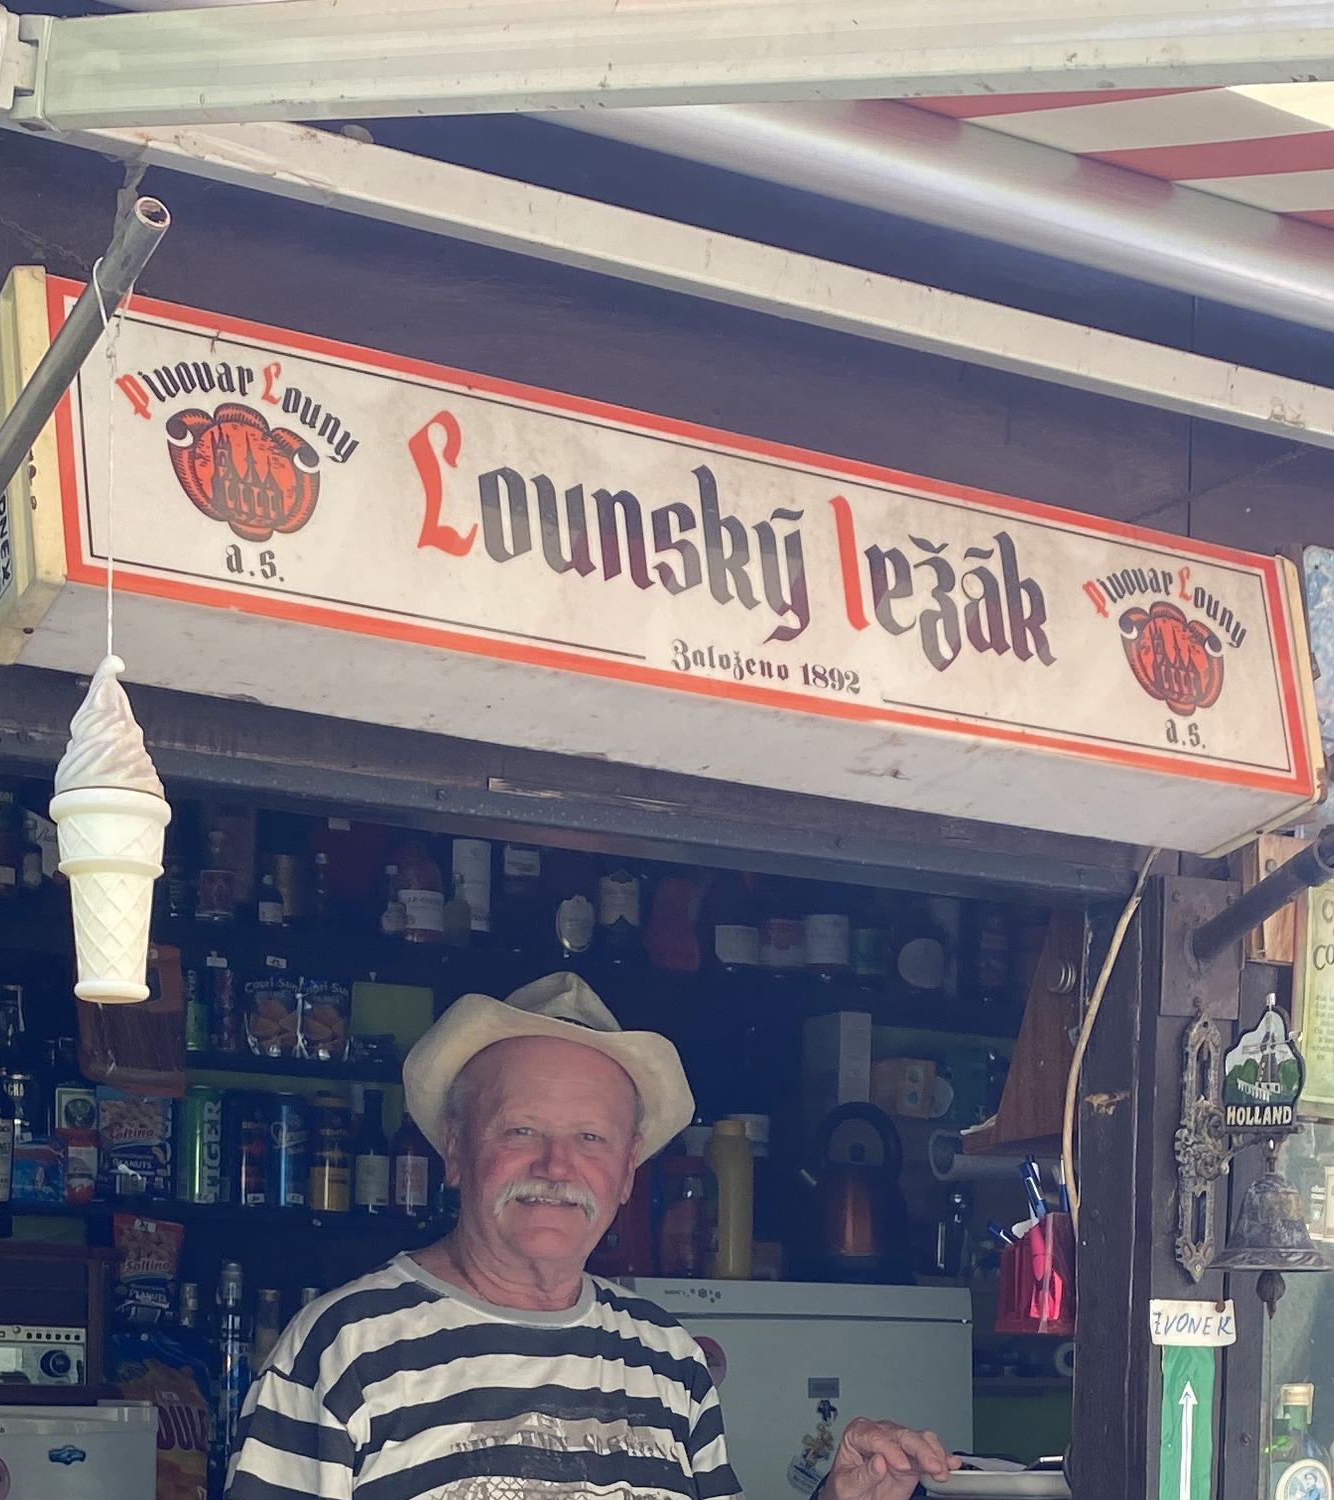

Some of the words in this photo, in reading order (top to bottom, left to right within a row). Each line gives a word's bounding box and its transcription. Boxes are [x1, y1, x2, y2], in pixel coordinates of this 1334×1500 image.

[116, 361, 256, 421] Pivovar
[262, 361, 360, 465] Louny
[408, 409, 811, 646] Lounský
[1082, 565, 1173, 617] Pivovar
[1178, 565, 1247, 648] Louny
[671, 638, 790, 683] Založeno
[801, 662, 861, 695] 1892
[1226, 1104, 1292, 1126] HOLLAND
[1153, 1309, 1234, 1337] ZVONEK
